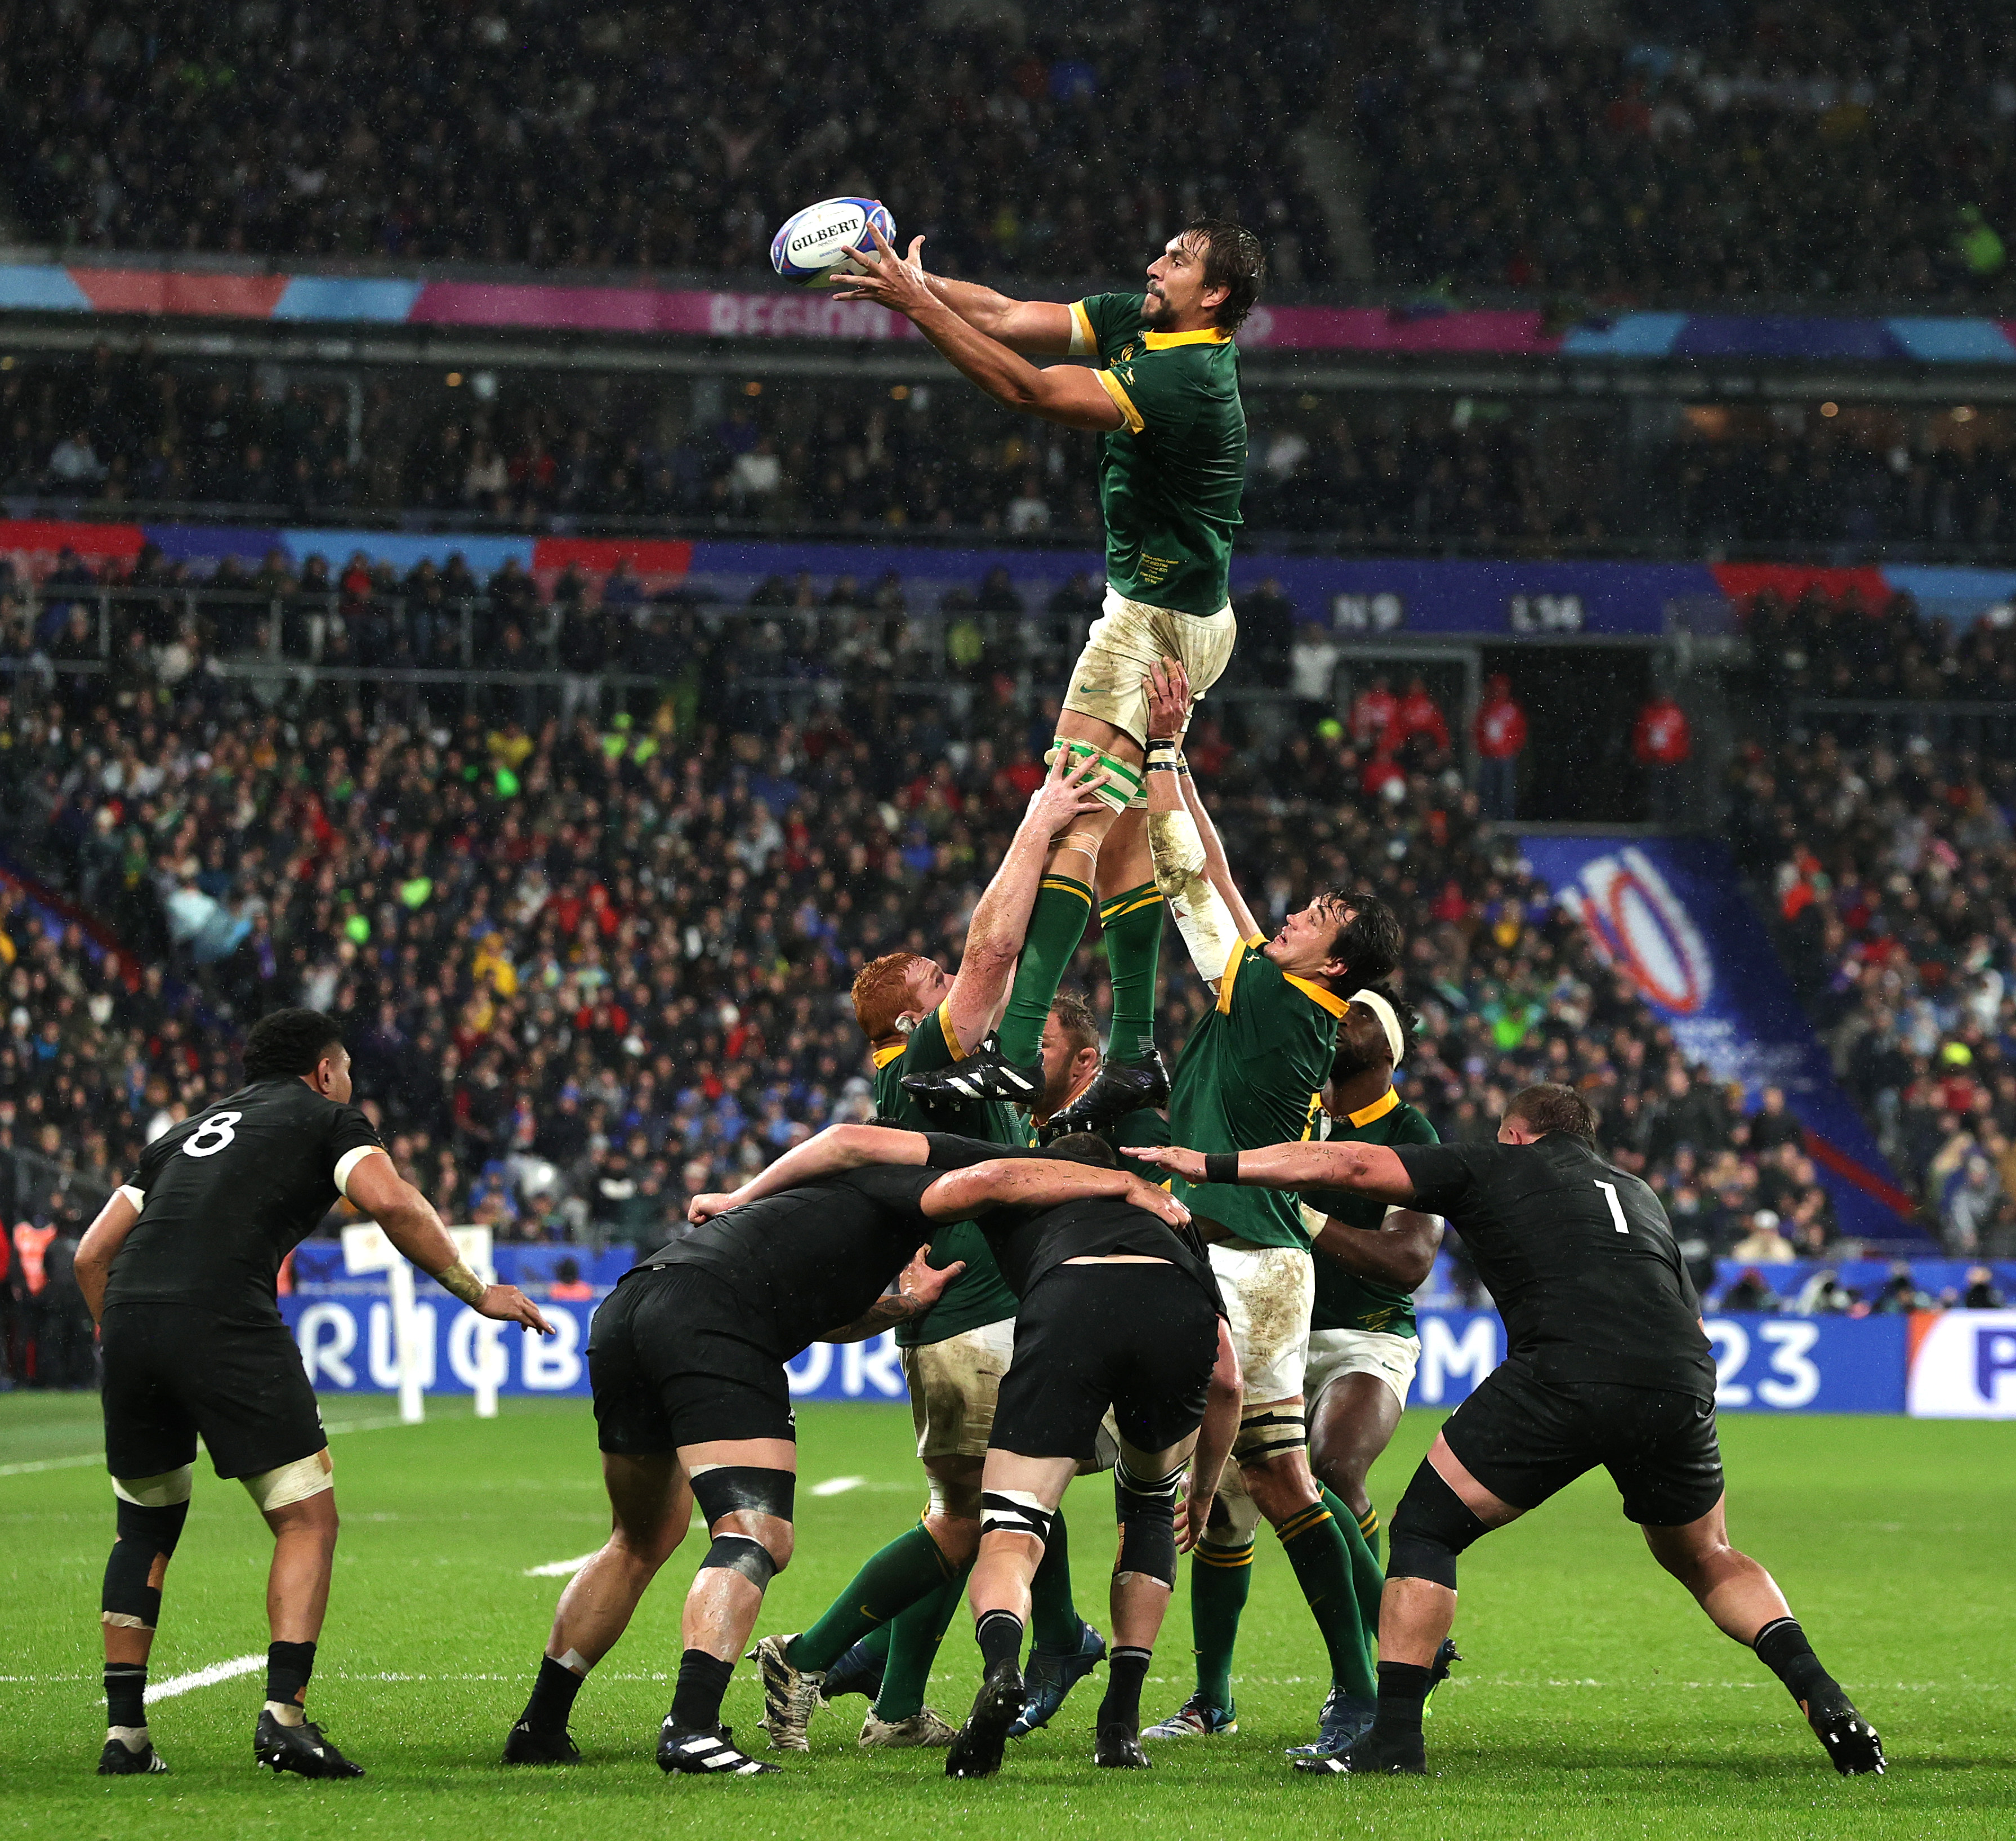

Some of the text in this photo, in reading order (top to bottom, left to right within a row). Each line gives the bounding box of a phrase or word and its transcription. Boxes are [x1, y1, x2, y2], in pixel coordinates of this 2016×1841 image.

[792, 219, 859, 251] GILBERT
[182, 1111, 242, 1157] 8
[1593, 1179, 1630, 1234] 1
[297, 1301, 597, 1390] RUGB
